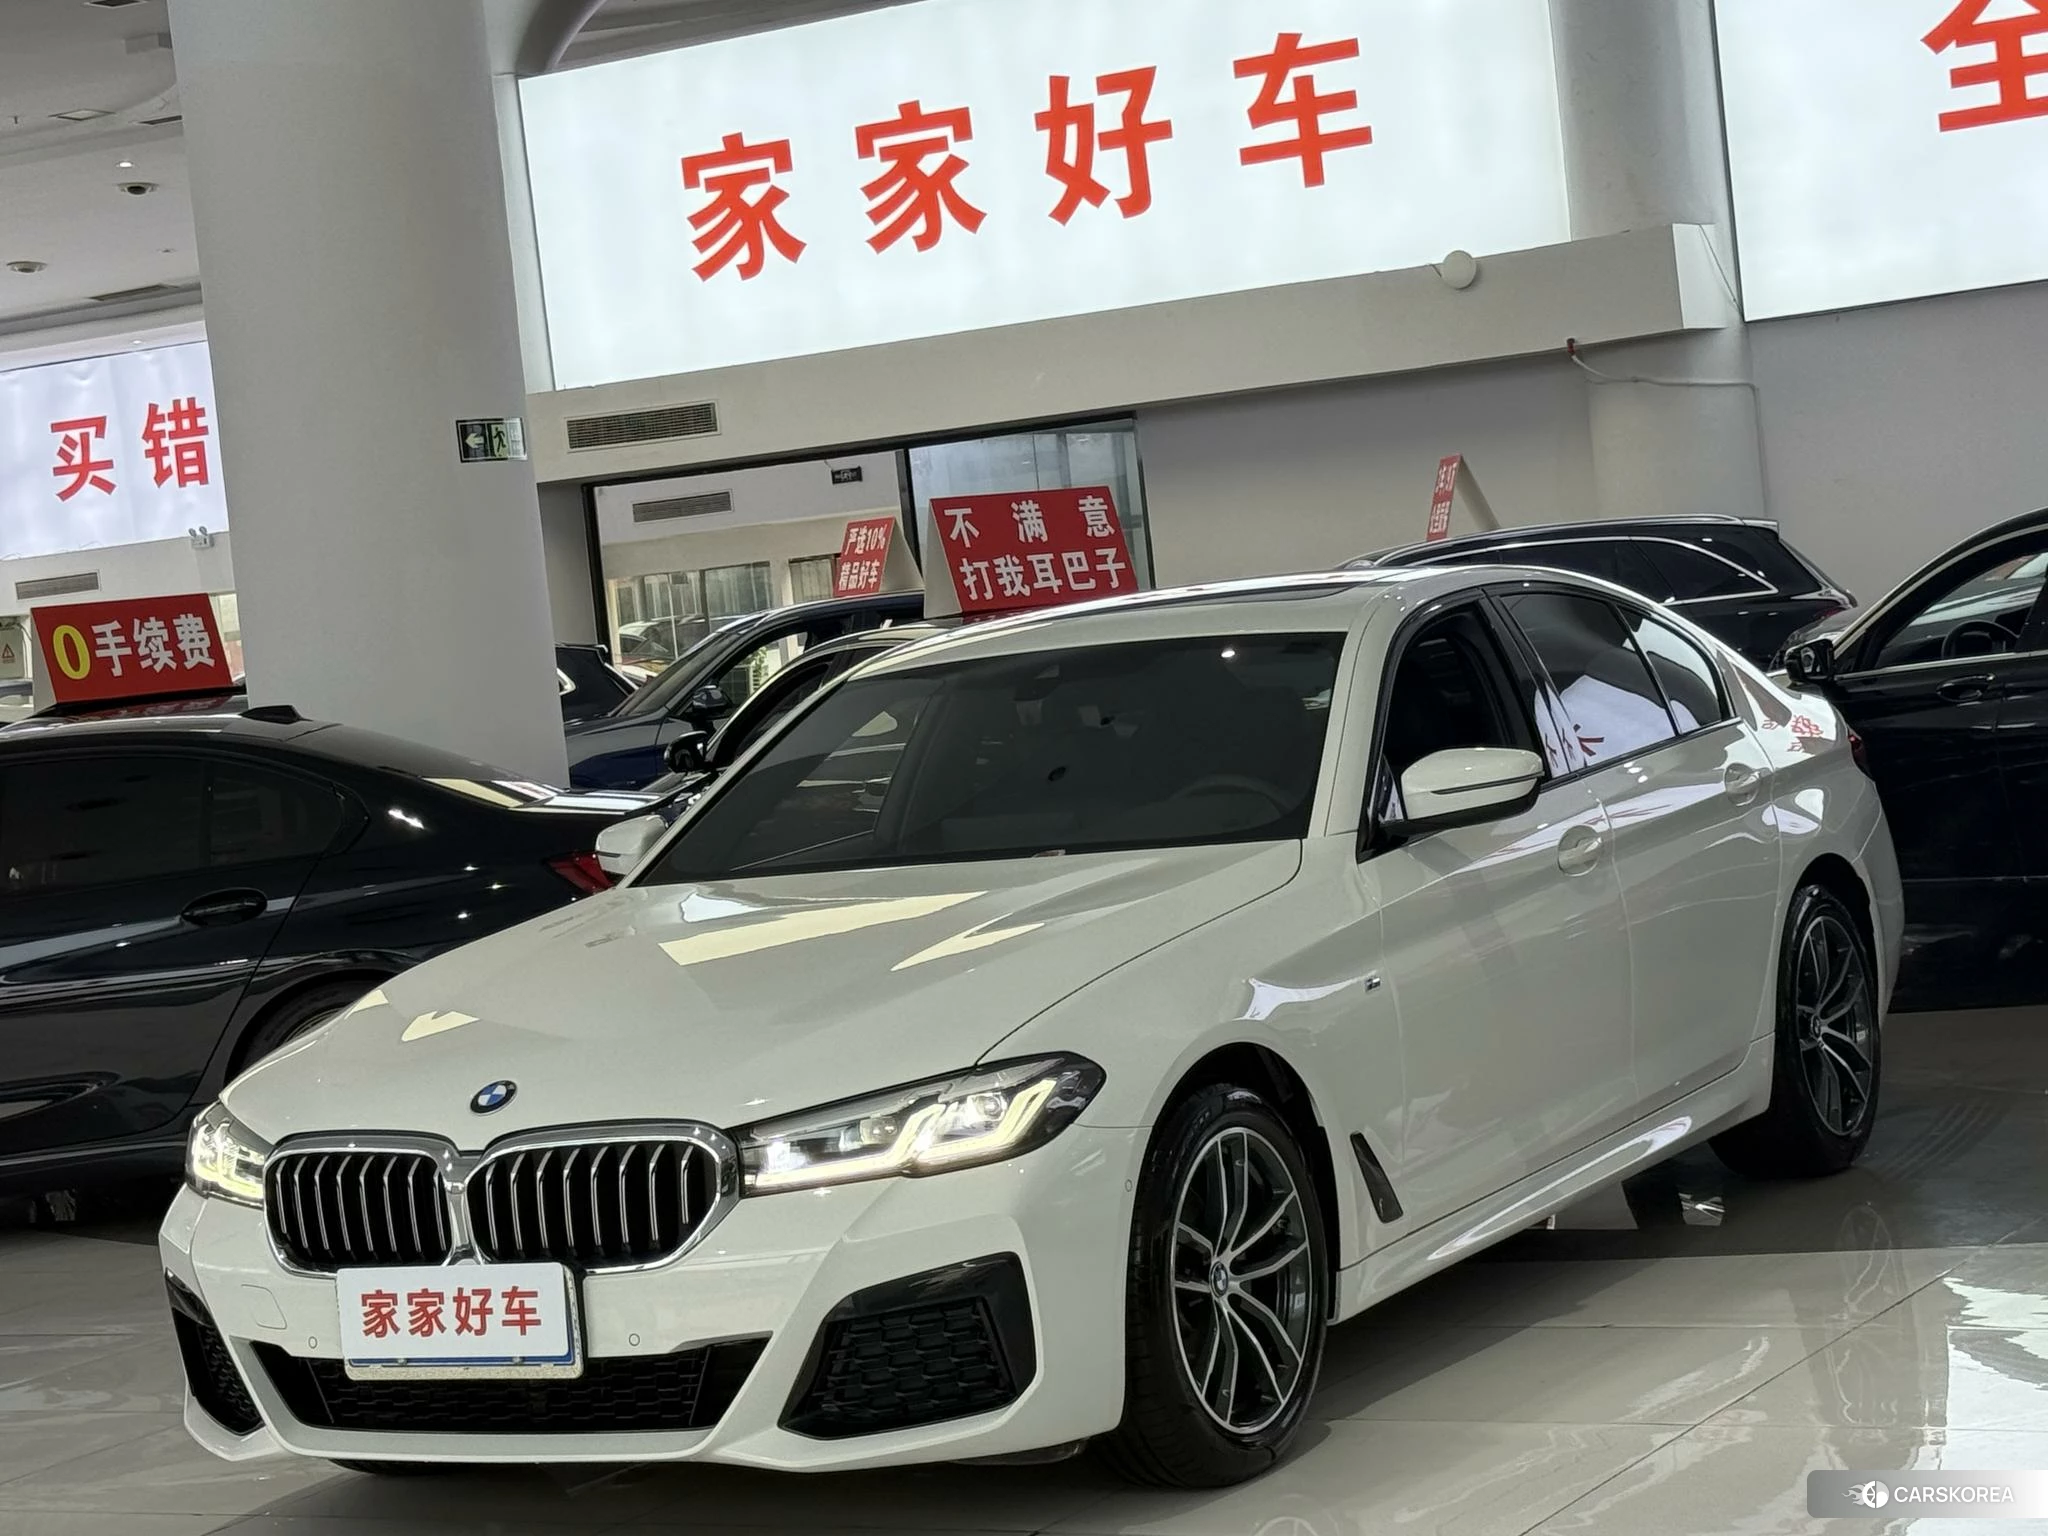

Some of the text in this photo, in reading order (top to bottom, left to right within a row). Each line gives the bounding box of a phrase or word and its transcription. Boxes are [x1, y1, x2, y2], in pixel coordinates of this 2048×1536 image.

[681, 32, 1372, 281] 家家好车
[51, 397, 209, 501] 买错
[944, 495, 1115, 548] 不满意
[959, 547, 1127, 601] 打我耳巴子
[53, 613, 215, 680] 0手续费
[361, 1286, 541, 1338] 家家好车
